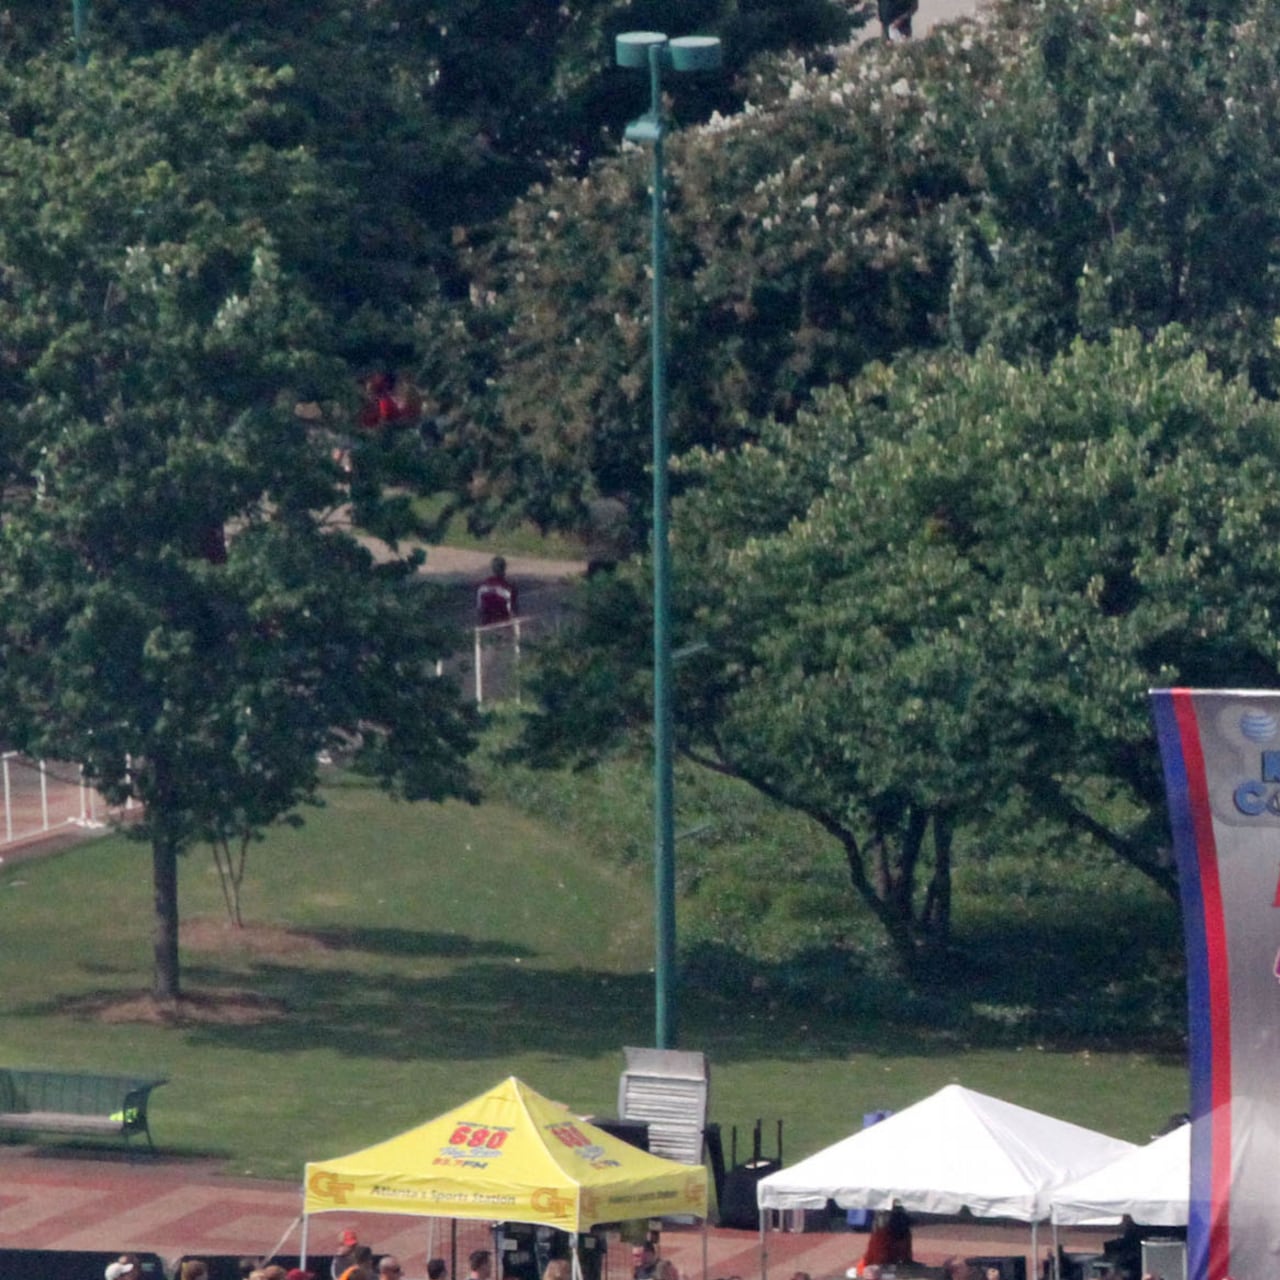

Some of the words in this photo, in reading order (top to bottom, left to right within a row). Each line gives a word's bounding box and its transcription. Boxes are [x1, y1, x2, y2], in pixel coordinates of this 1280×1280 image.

[449, 1126, 509, 1149] 680
[309, 1171, 354, 1204] GT
[431, 1189, 468, 1204] Sports
[473, 1190, 516, 1206] Station
[530, 1187, 574, 1218] GT
